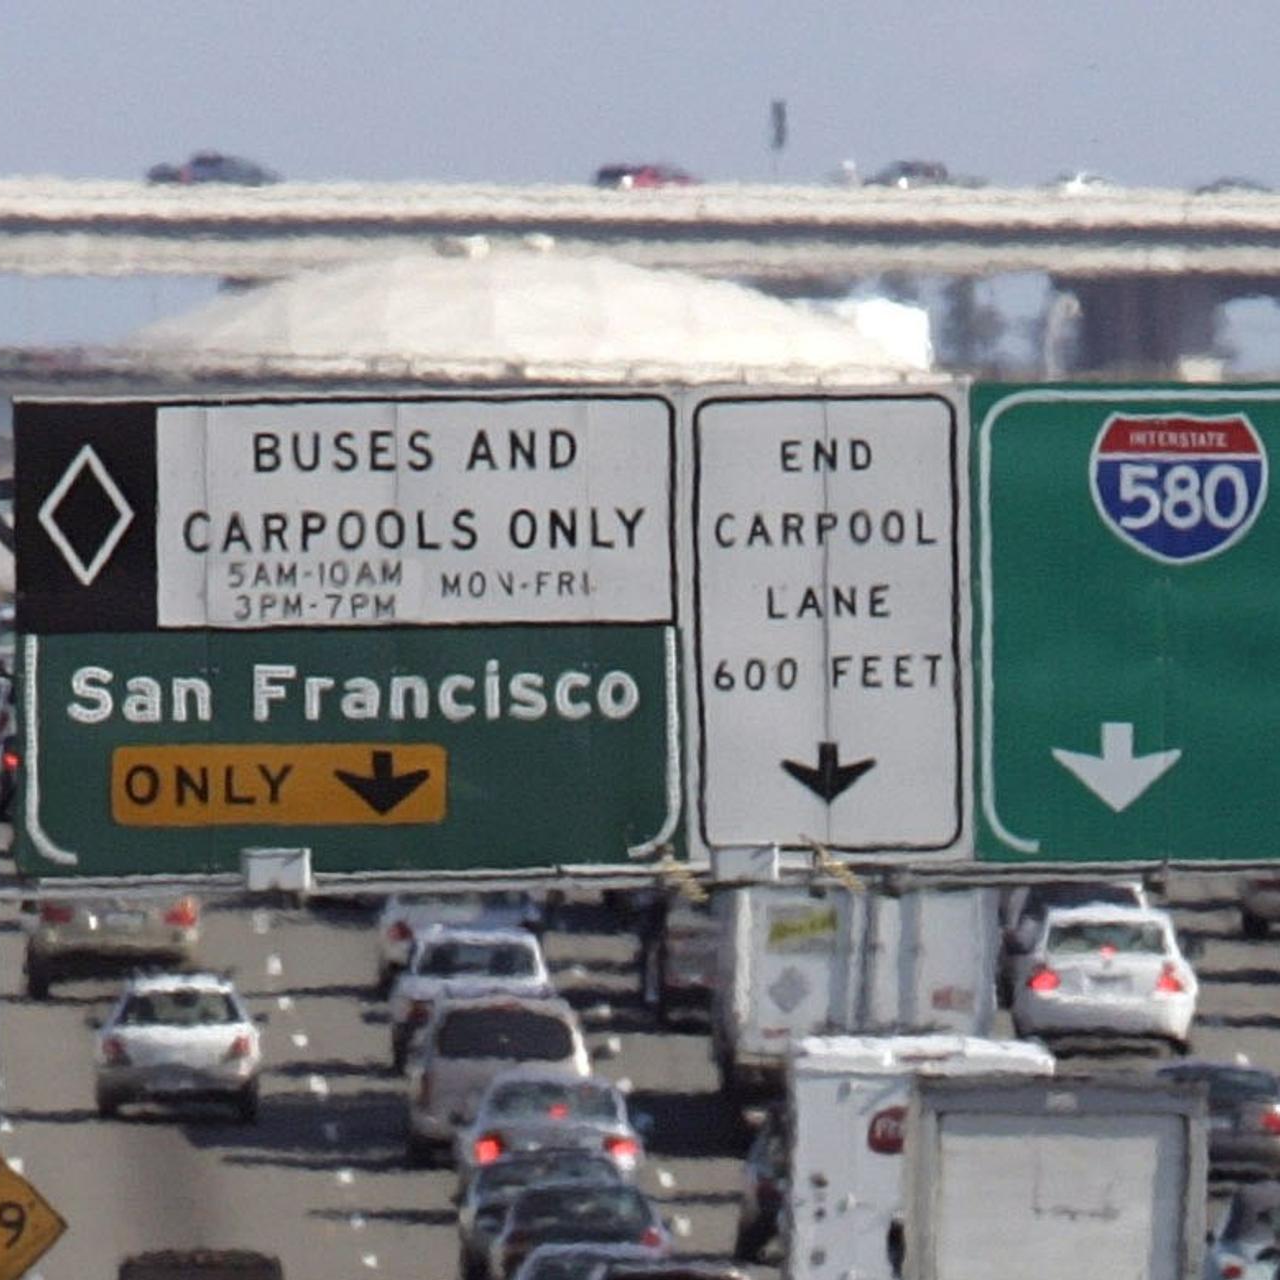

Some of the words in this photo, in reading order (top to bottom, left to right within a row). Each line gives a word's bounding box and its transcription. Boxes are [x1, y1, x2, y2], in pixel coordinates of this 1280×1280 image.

[254, 431, 433, 472] BUSES
[467, 430, 576, 470] AND
[781, 439, 871, 472] END
[1128, 430, 1230, 449] INTERSTATE
[1118, 464, 1251, 530] 580
[183, 509, 477, 553] CARPOOLS
[510, 509, 644, 549] ONLY
[715, 510, 936, 548] CARPOOL
[227, 561, 404, 588] 5AM-10AM
[233, 594, 398, 621] 3PM-7PM
[768, 582, 888, 619] LANE
[67, 666, 210, 723] San
[254, 659, 639, 721] Francisco
[714, 658, 797, 691] 600
[833, 656, 945, 690] FEET
[125, 765, 291, 806] ONLY
